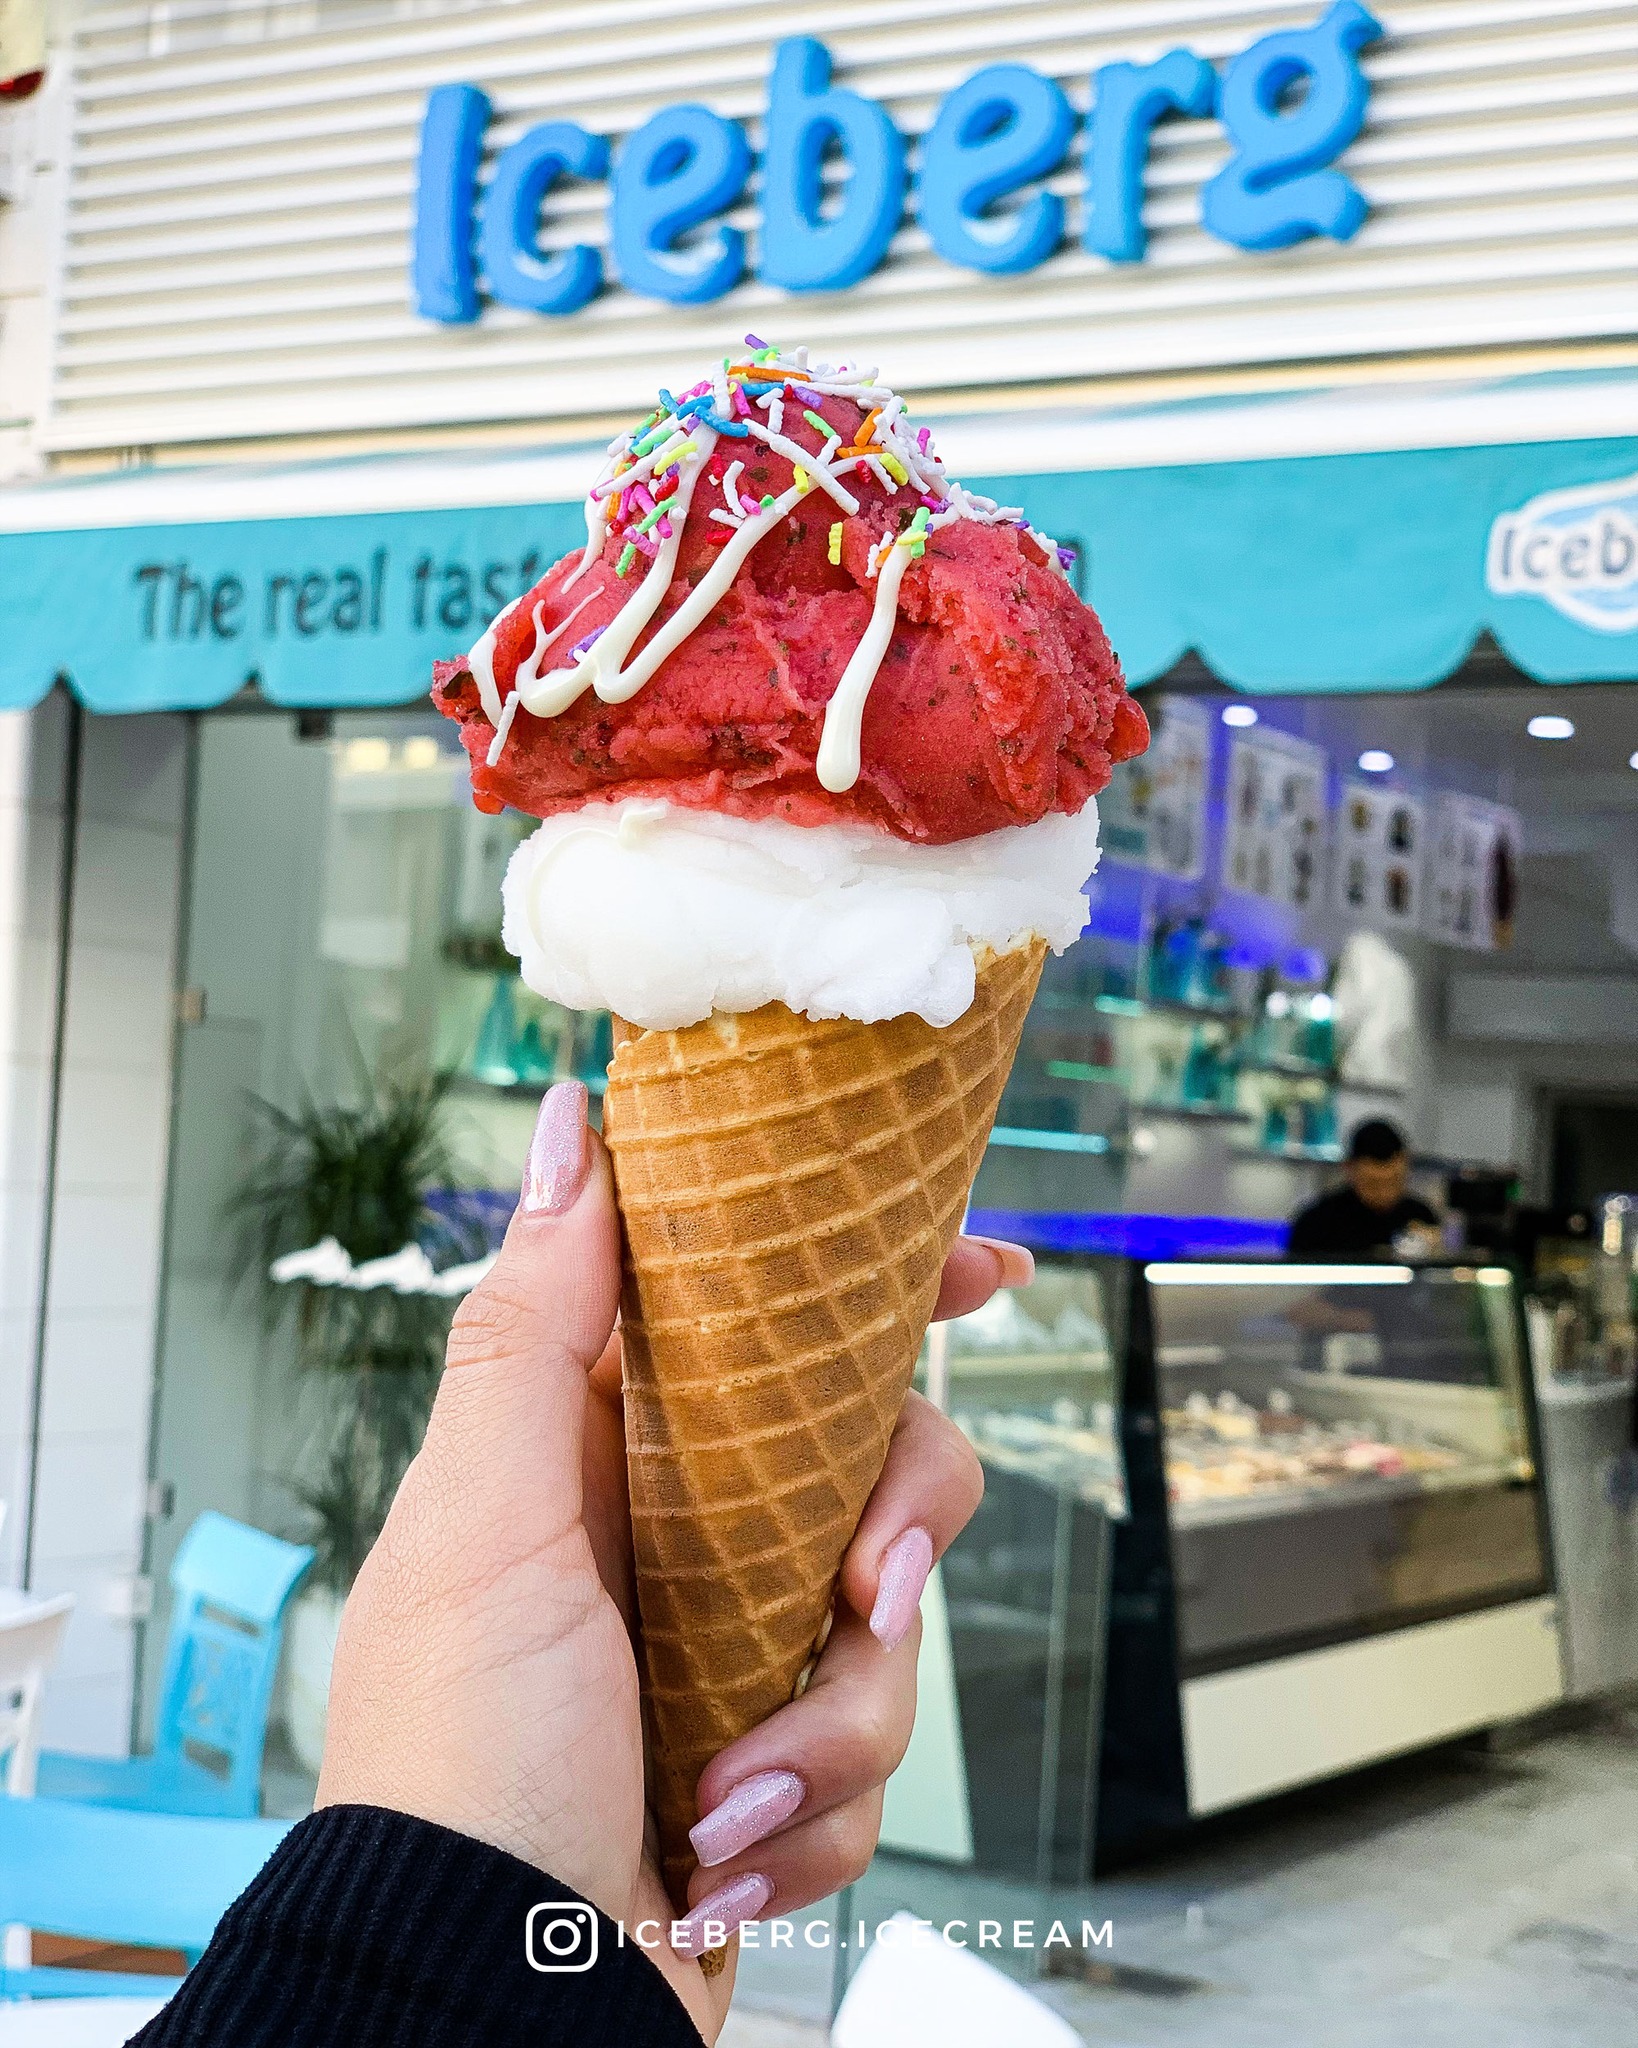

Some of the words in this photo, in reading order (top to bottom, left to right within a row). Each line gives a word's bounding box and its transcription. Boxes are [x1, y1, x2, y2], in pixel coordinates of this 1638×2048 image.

[412, 0, 1384, 325] Iceberg
[134, 560, 242, 638] The
[266, 544, 388, 637] real
